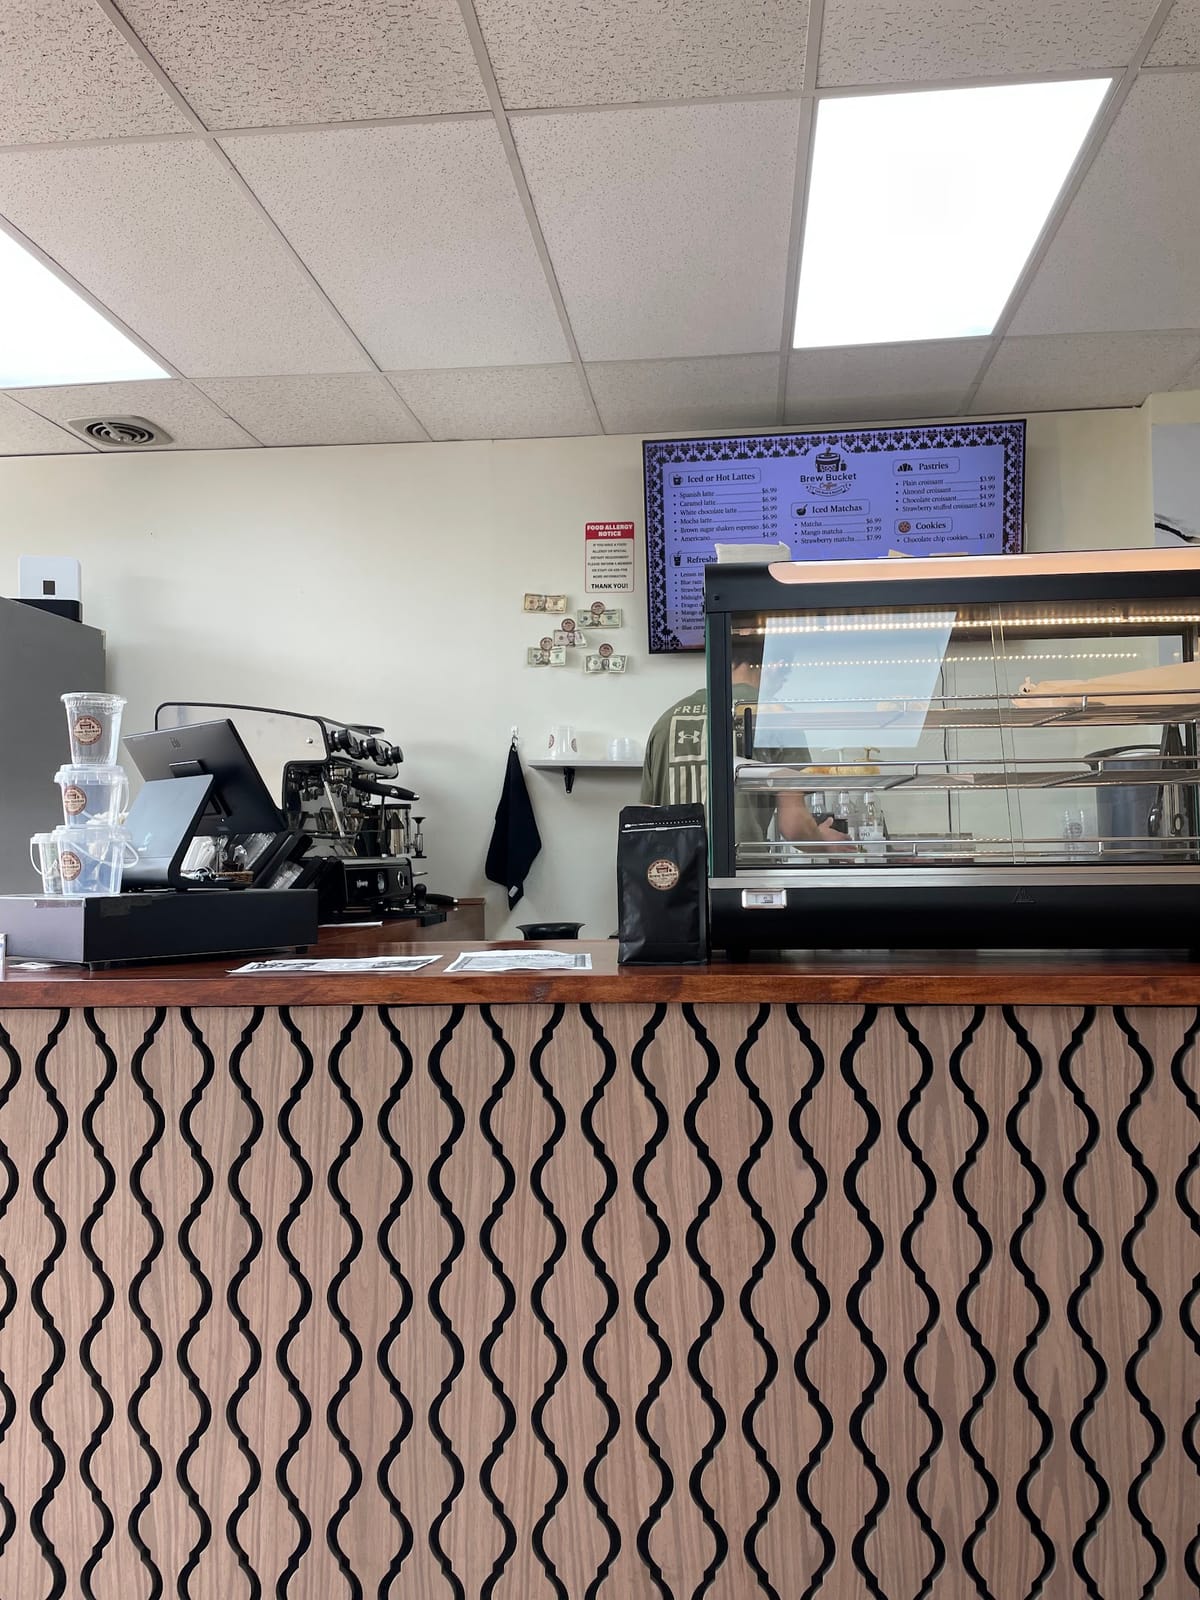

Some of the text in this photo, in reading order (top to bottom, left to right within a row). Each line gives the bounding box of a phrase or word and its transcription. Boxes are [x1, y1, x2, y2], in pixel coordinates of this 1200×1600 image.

[919, 462, 949, 470] Pastries
[687, 475, 704, 483] Iced
[732, 473, 756, 481] Lattes
[800, 473, 857, 483] Brew Bucket
[812, 504, 863, 514] Iced Matchas
[916, 521, 946, 530] Cookies
